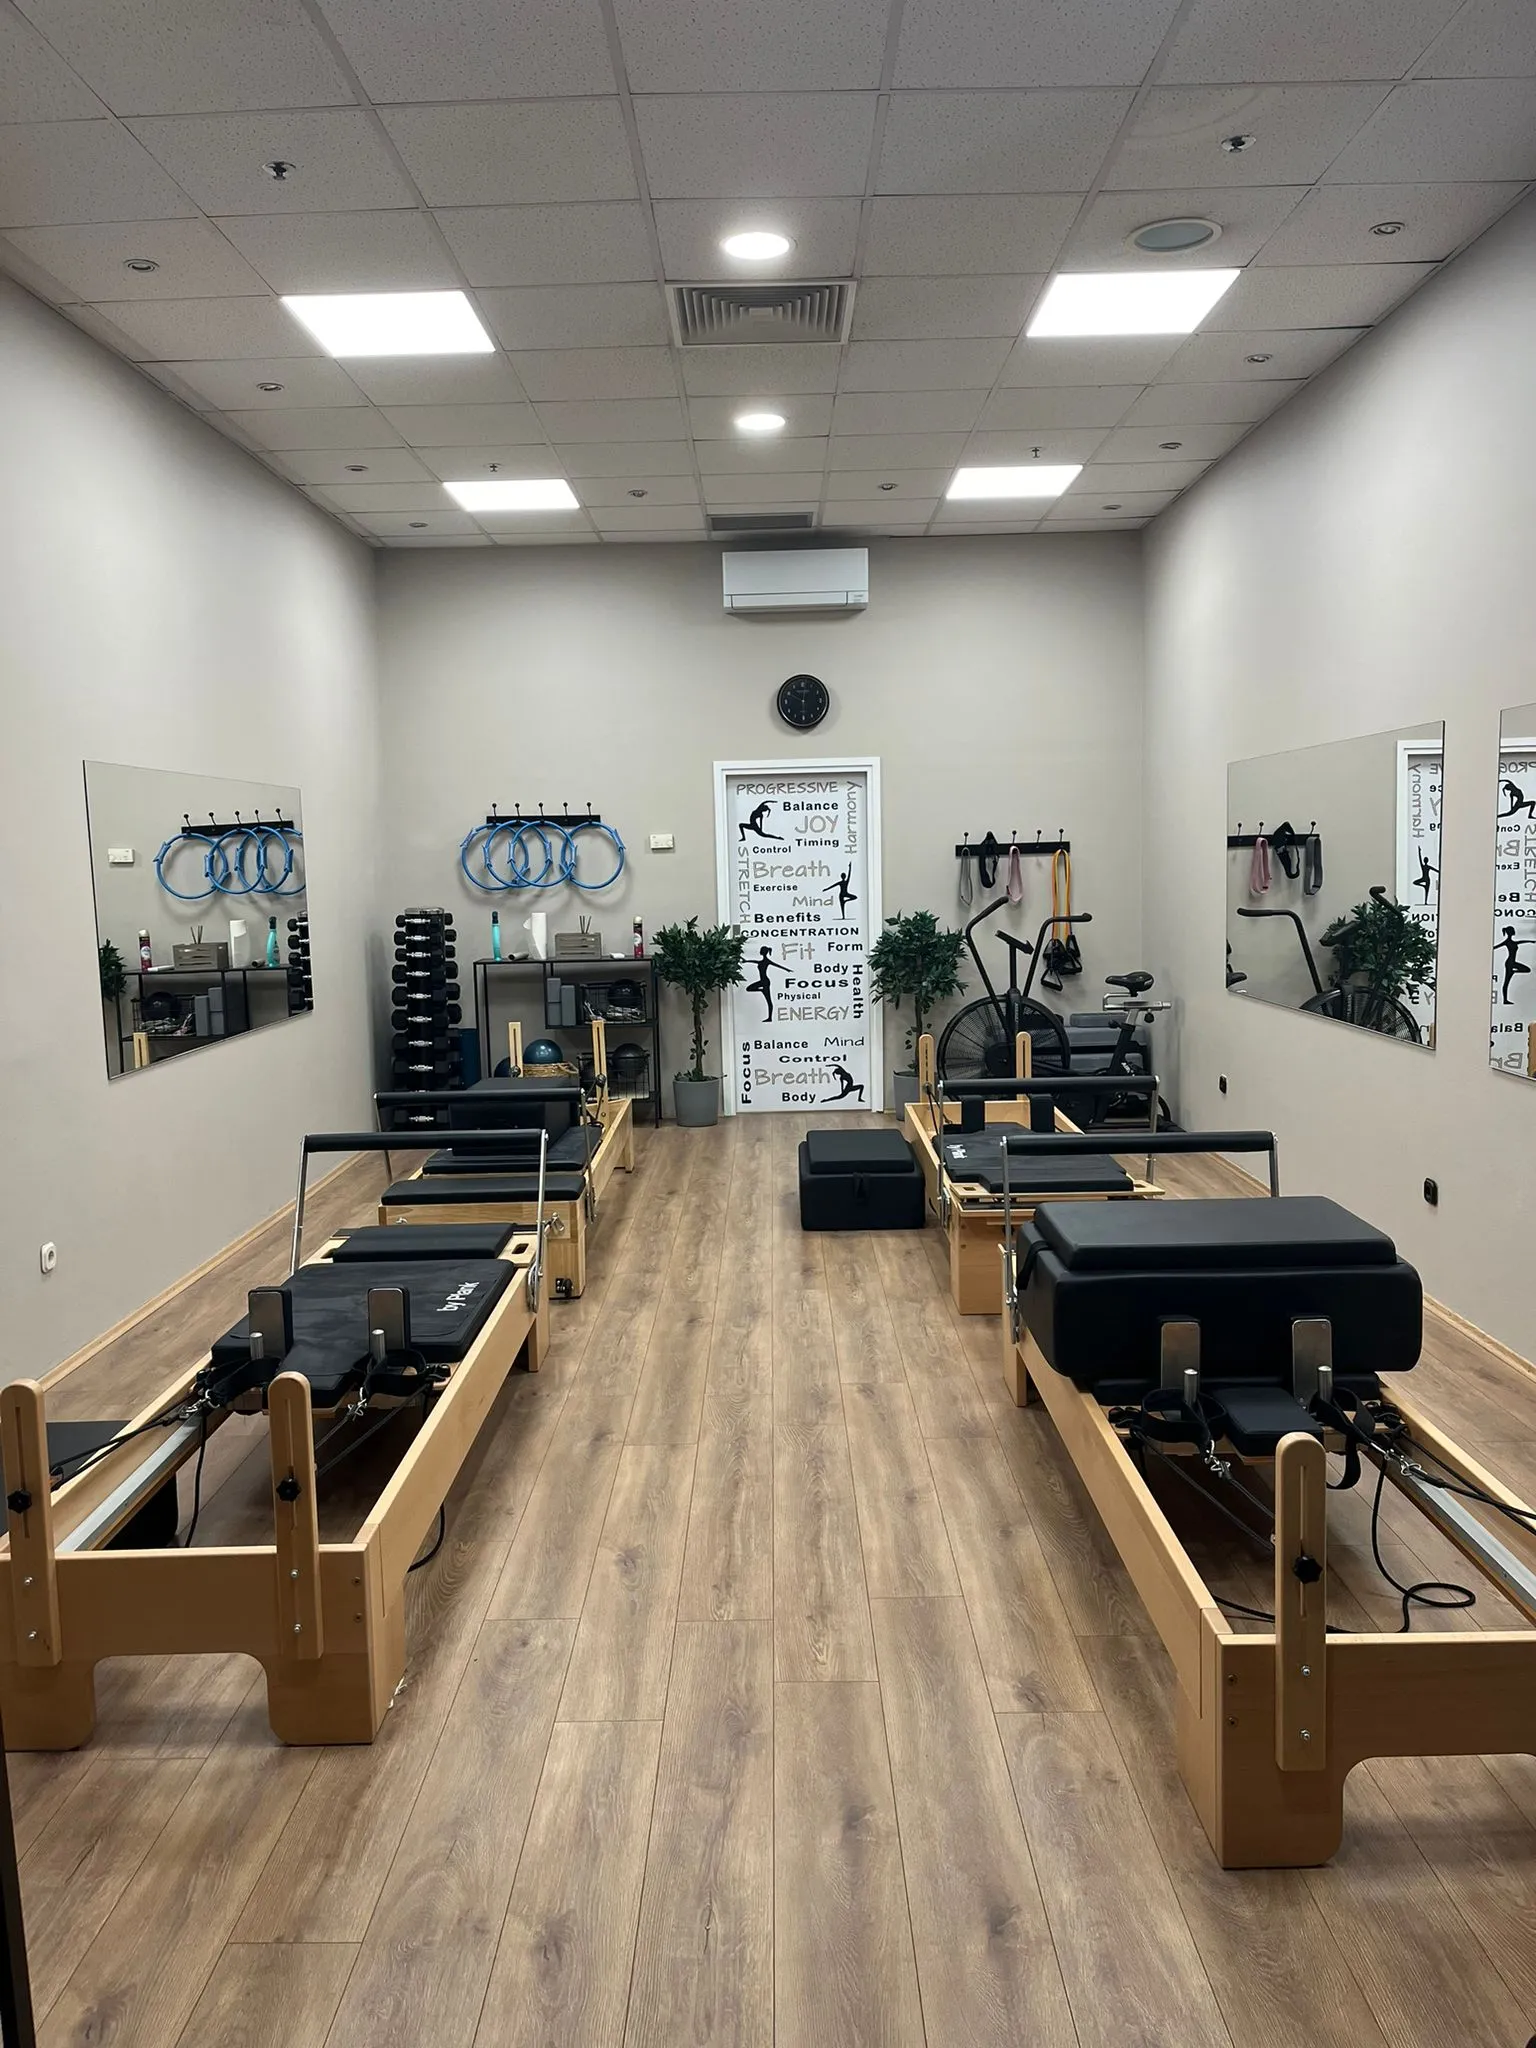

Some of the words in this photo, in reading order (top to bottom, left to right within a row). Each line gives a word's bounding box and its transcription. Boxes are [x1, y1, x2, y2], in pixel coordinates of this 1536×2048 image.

[736, 782, 838, 795] PROGRESSIVE
[783, 801, 838, 811] Balance
[845, 781, 862, 854] Harmony
[795, 815, 838, 833] JOY
[795, 839, 839, 847] Timing
[753, 860, 830, 878] Breath
[738, 846, 751, 924] STRETCH
[792, 896, 834, 907] Mind
[754, 912, 821, 923] Benefits
[741, 928, 859, 937] CONCENTRATION
[781, 942, 815, 960] Fit
[828, 942, 862, 951] Form
[814, 964, 848, 975] Body
[785, 978, 848, 988] Focus
[777, 992, 821, 1000] Physical
[853, 965, 863, 1018] Health
[777, 1006, 849, 1021] ENERGY
[754, 1040, 808, 1050] Balance
[824, 1037, 864, 1047] Mind
[779, 1055, 847, 1063] Control
[742, 1042, 751, 1104] Focus
[755, 1068, 830, 1085] Breath
[782, 1092, 816, 1103] Body
[436, 1301, 466, 1311] by
